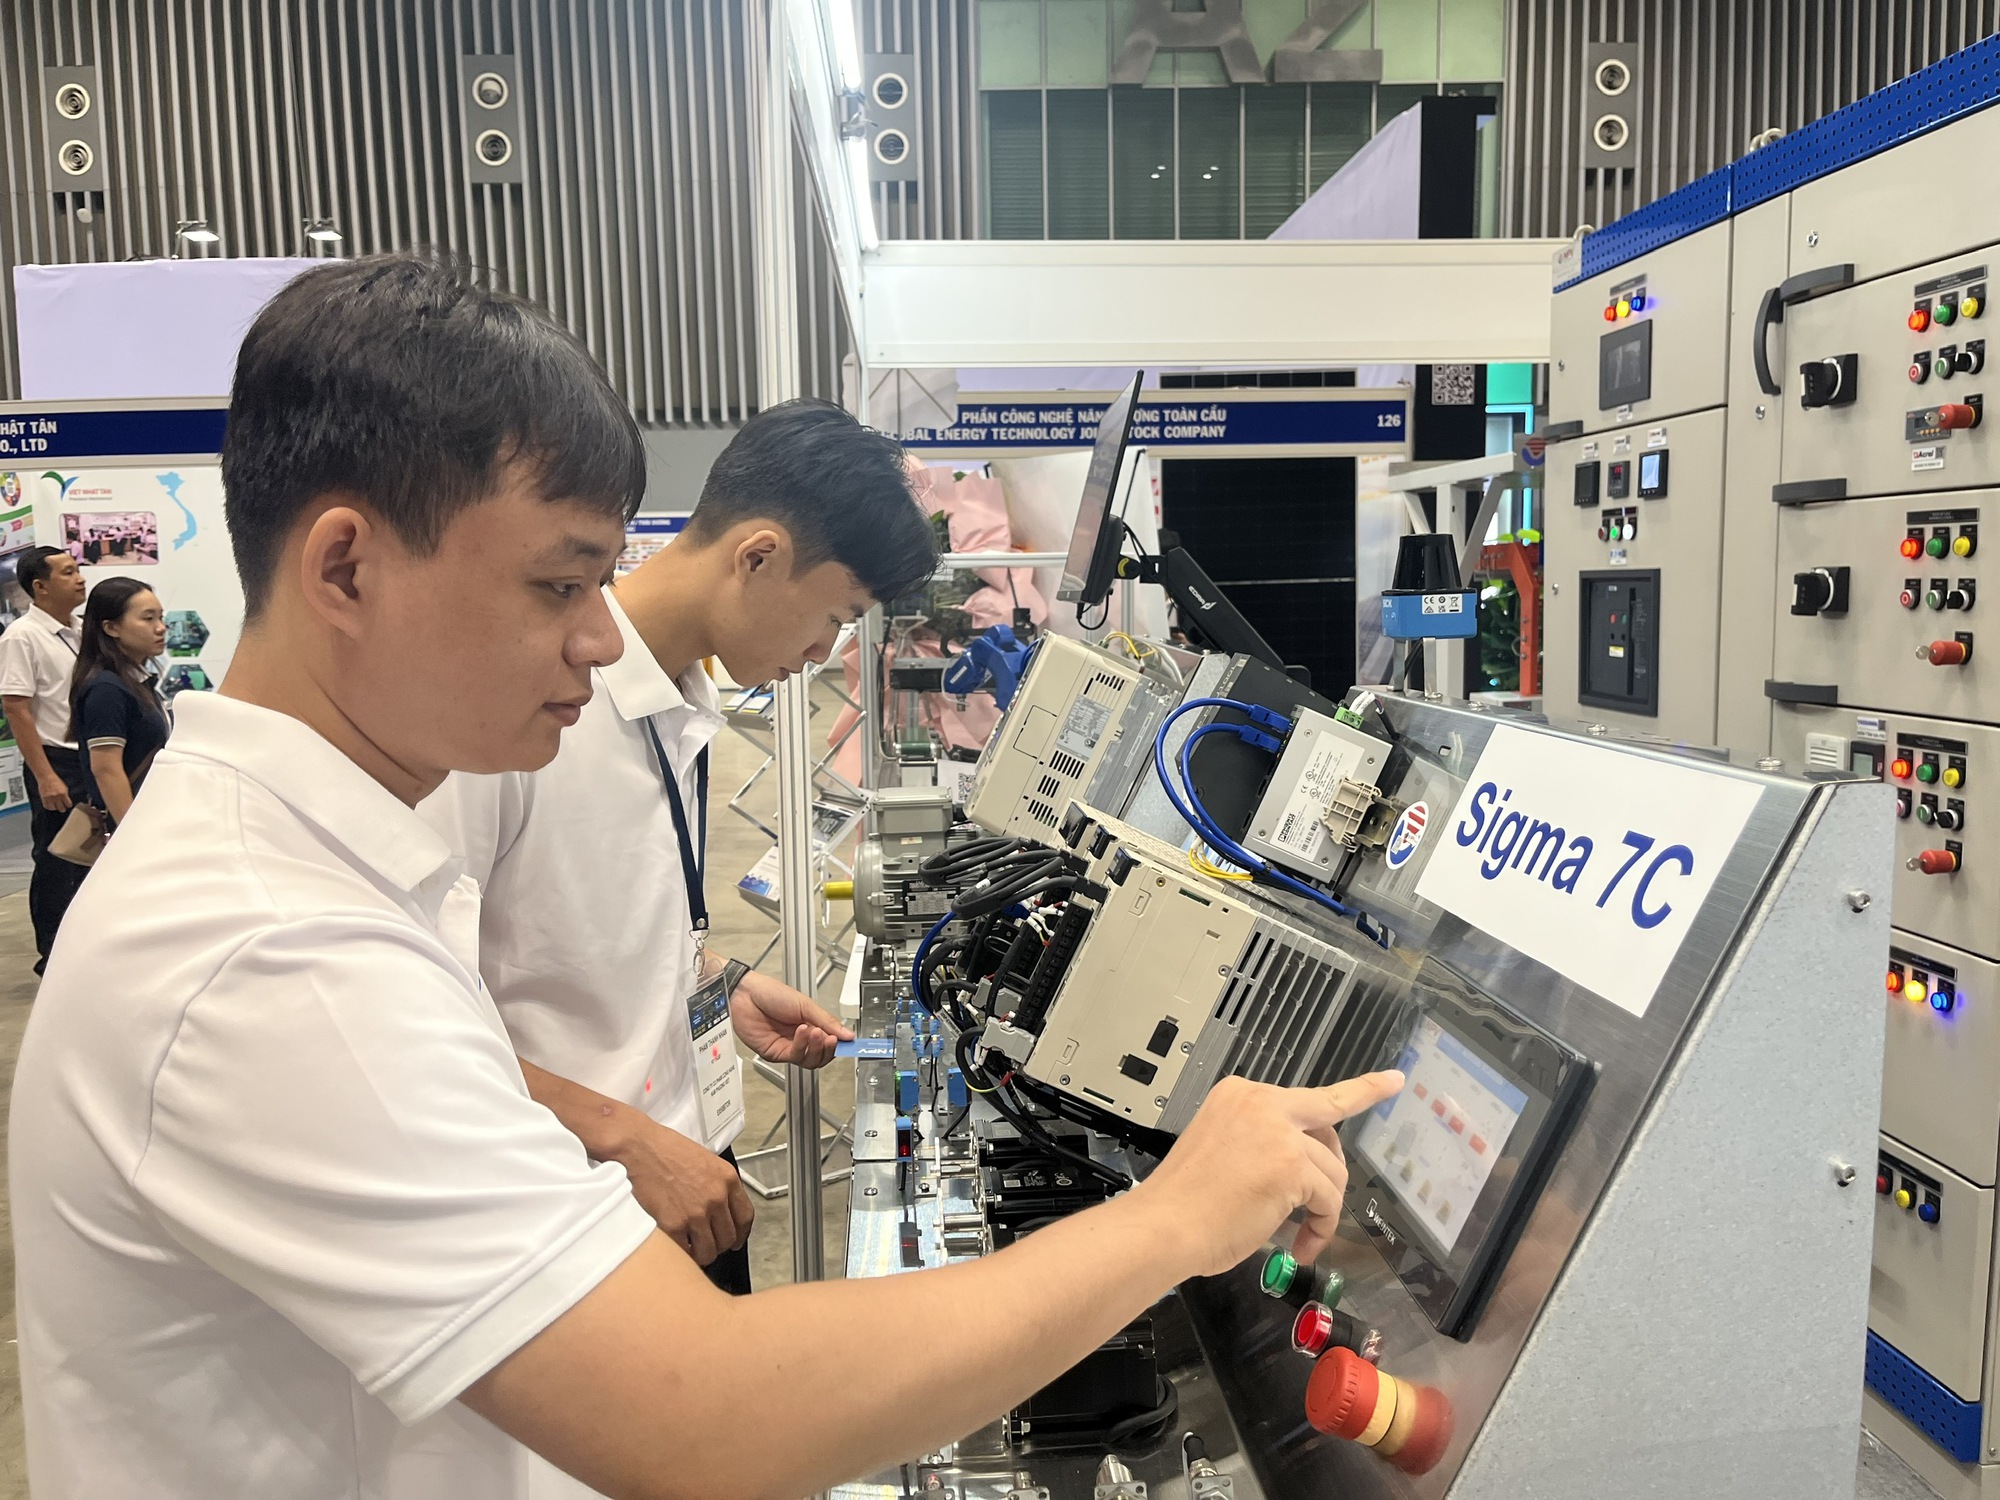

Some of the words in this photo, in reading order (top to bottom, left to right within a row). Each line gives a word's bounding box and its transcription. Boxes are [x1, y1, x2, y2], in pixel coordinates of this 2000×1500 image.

[1000, 408, 1036, 424] CÔNG
[1039, 408, 1075, 426] NGHỆ
[1078, 408, 1105, 423] NĂN
[1133, 408, 1160, 426] ỢNG
[1162, 406, 1197, 421] TOÀN
[1377, 414, 1401, 427] 126
[29, 418, 57, 434] TÂN
[936, 427, 987, 441] ENERGY
[991, 427, 1076, 441] TECHNOLOGY
[1079, 426, 1099, 439] JOI
[1128, 426, 1160, 438] TOCK
[1164, 425, 1226, 438] COMPANY
[21, 438, 48, 452] LTD
[1456, 781, 1594, 895] Sigma
[1595, 830, 1694, 929] 7C
